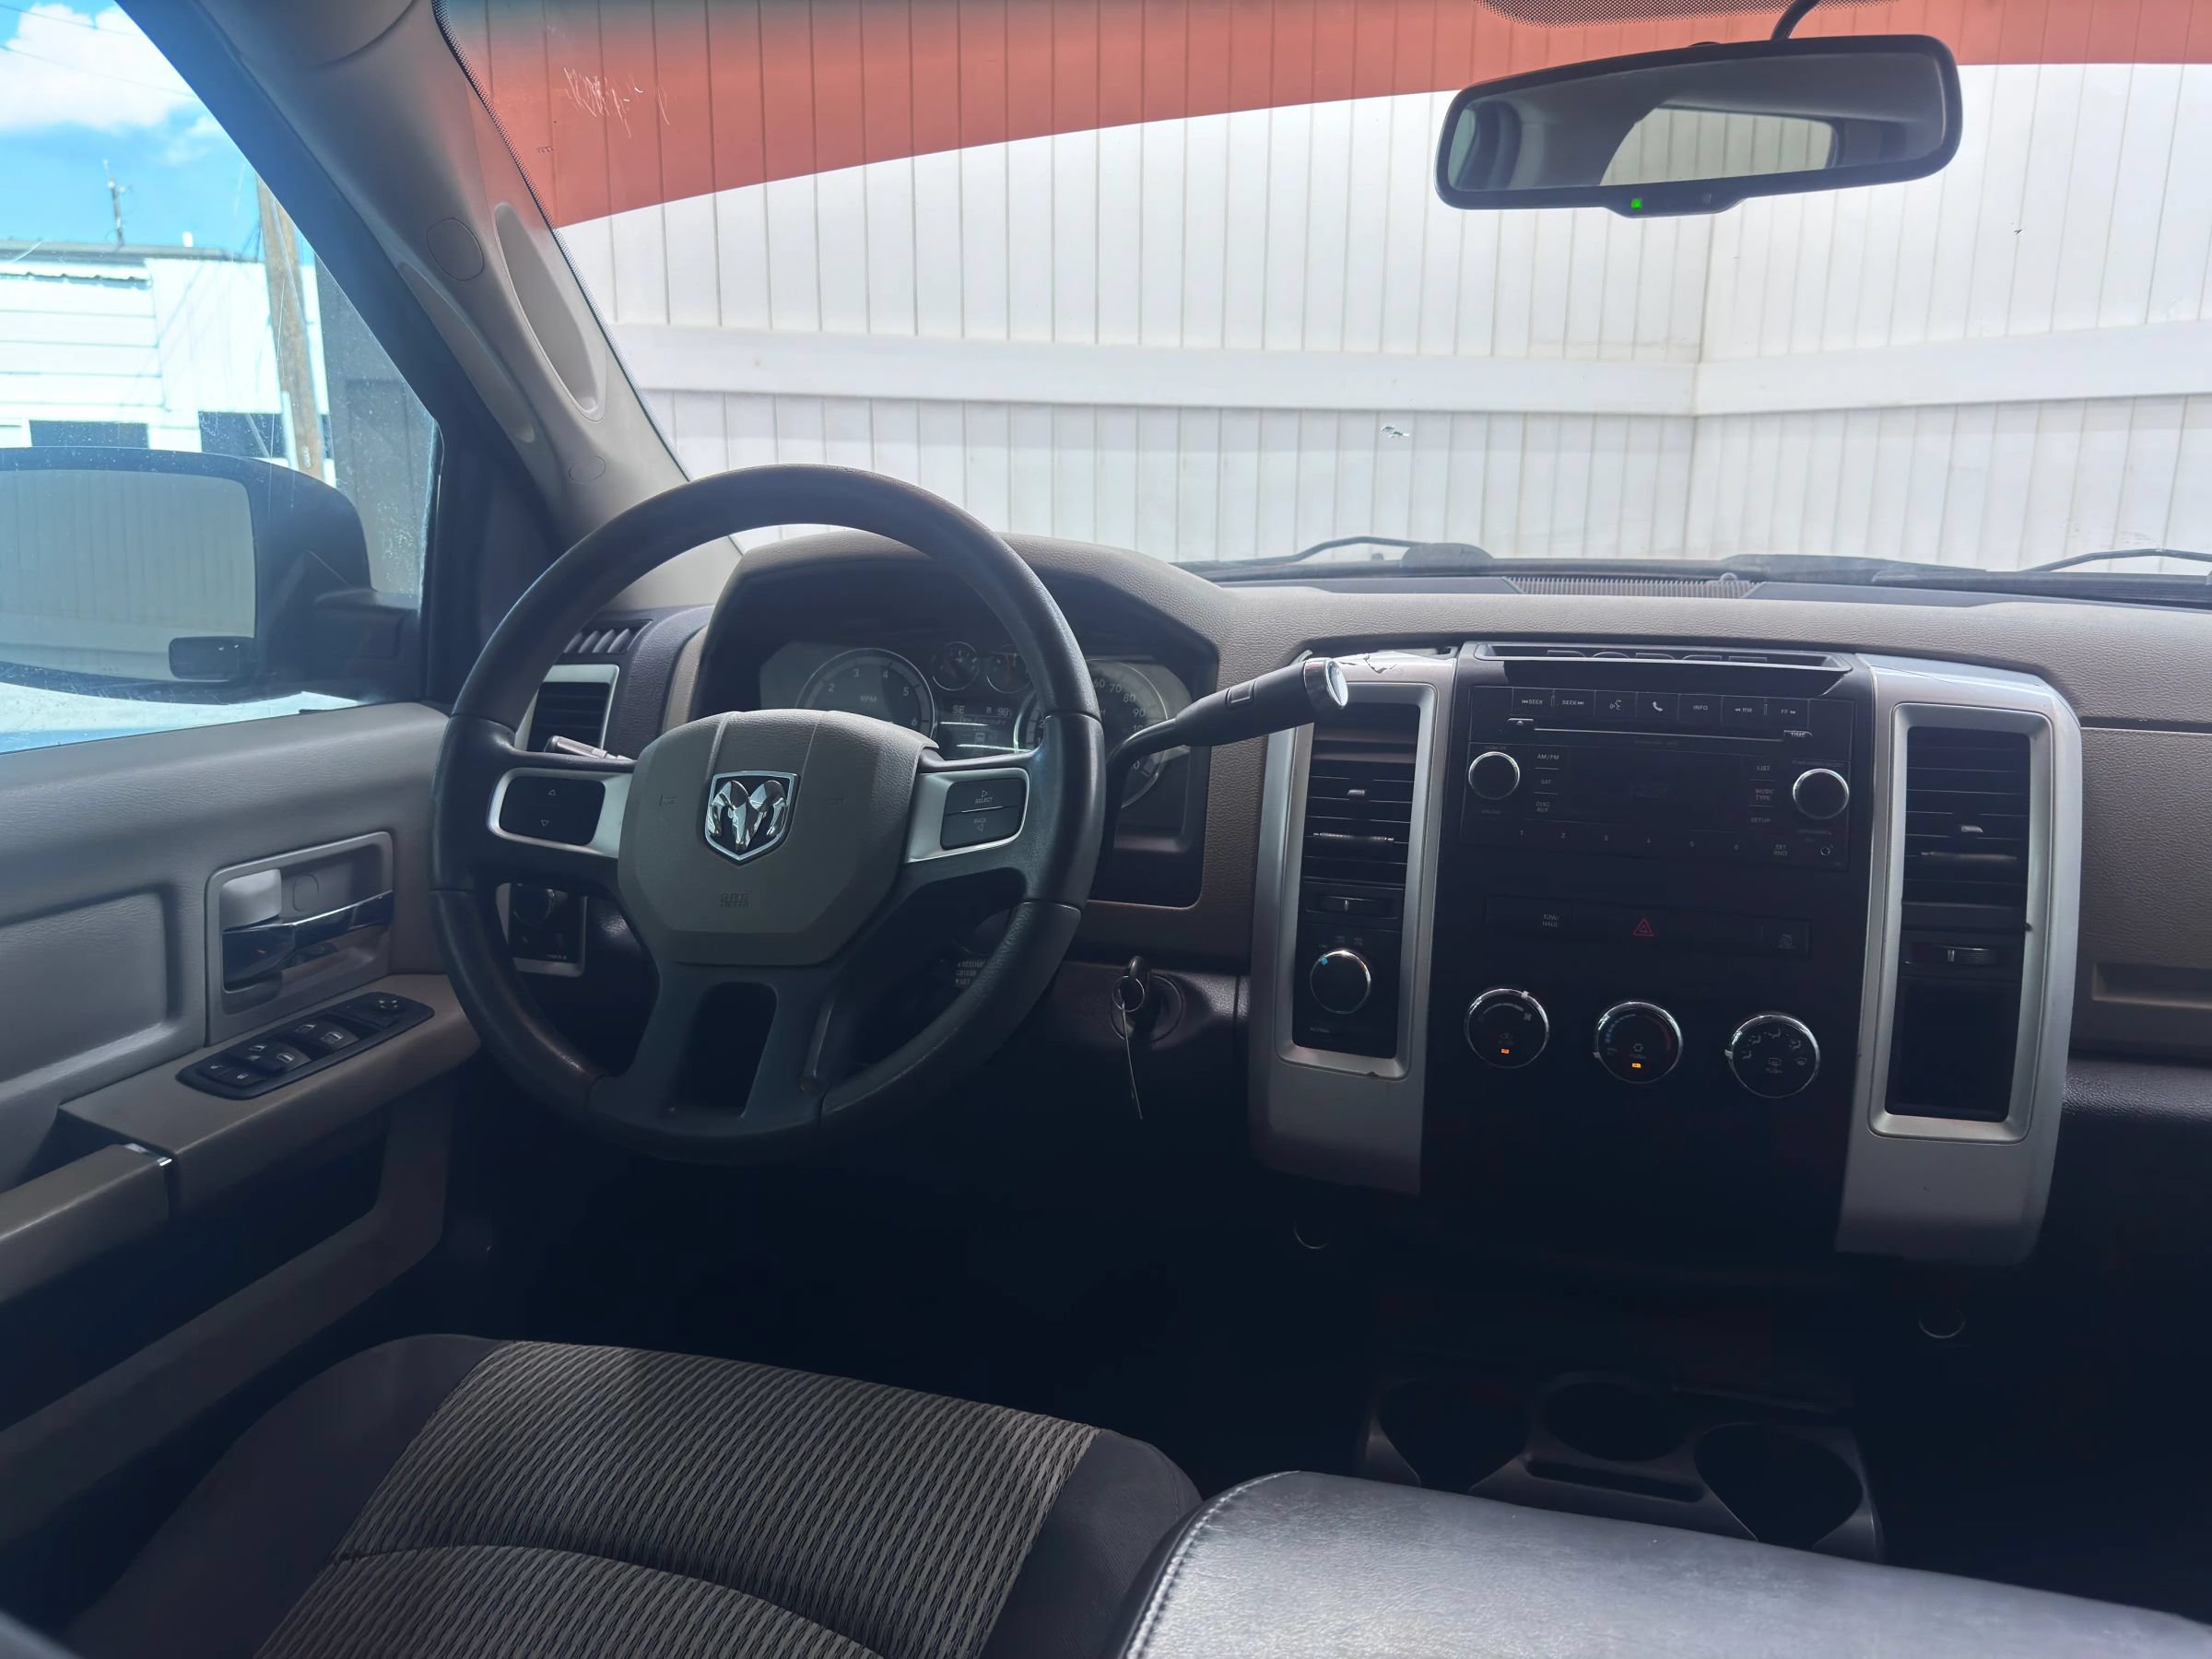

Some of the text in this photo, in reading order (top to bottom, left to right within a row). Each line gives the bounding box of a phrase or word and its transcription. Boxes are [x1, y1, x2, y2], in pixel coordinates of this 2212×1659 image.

[853, 668, 860, 678] 3
[882, 670, 888, 679] 4
[828, 682, 836, 693] 2
[902, 687, 910, 697] 5
[1109, 684, 1123, 693] 70
[1124, 693, 1136, 703] 80
[1133, 708, 1147, 717] 90
[912, 717, 918, 726] 6
